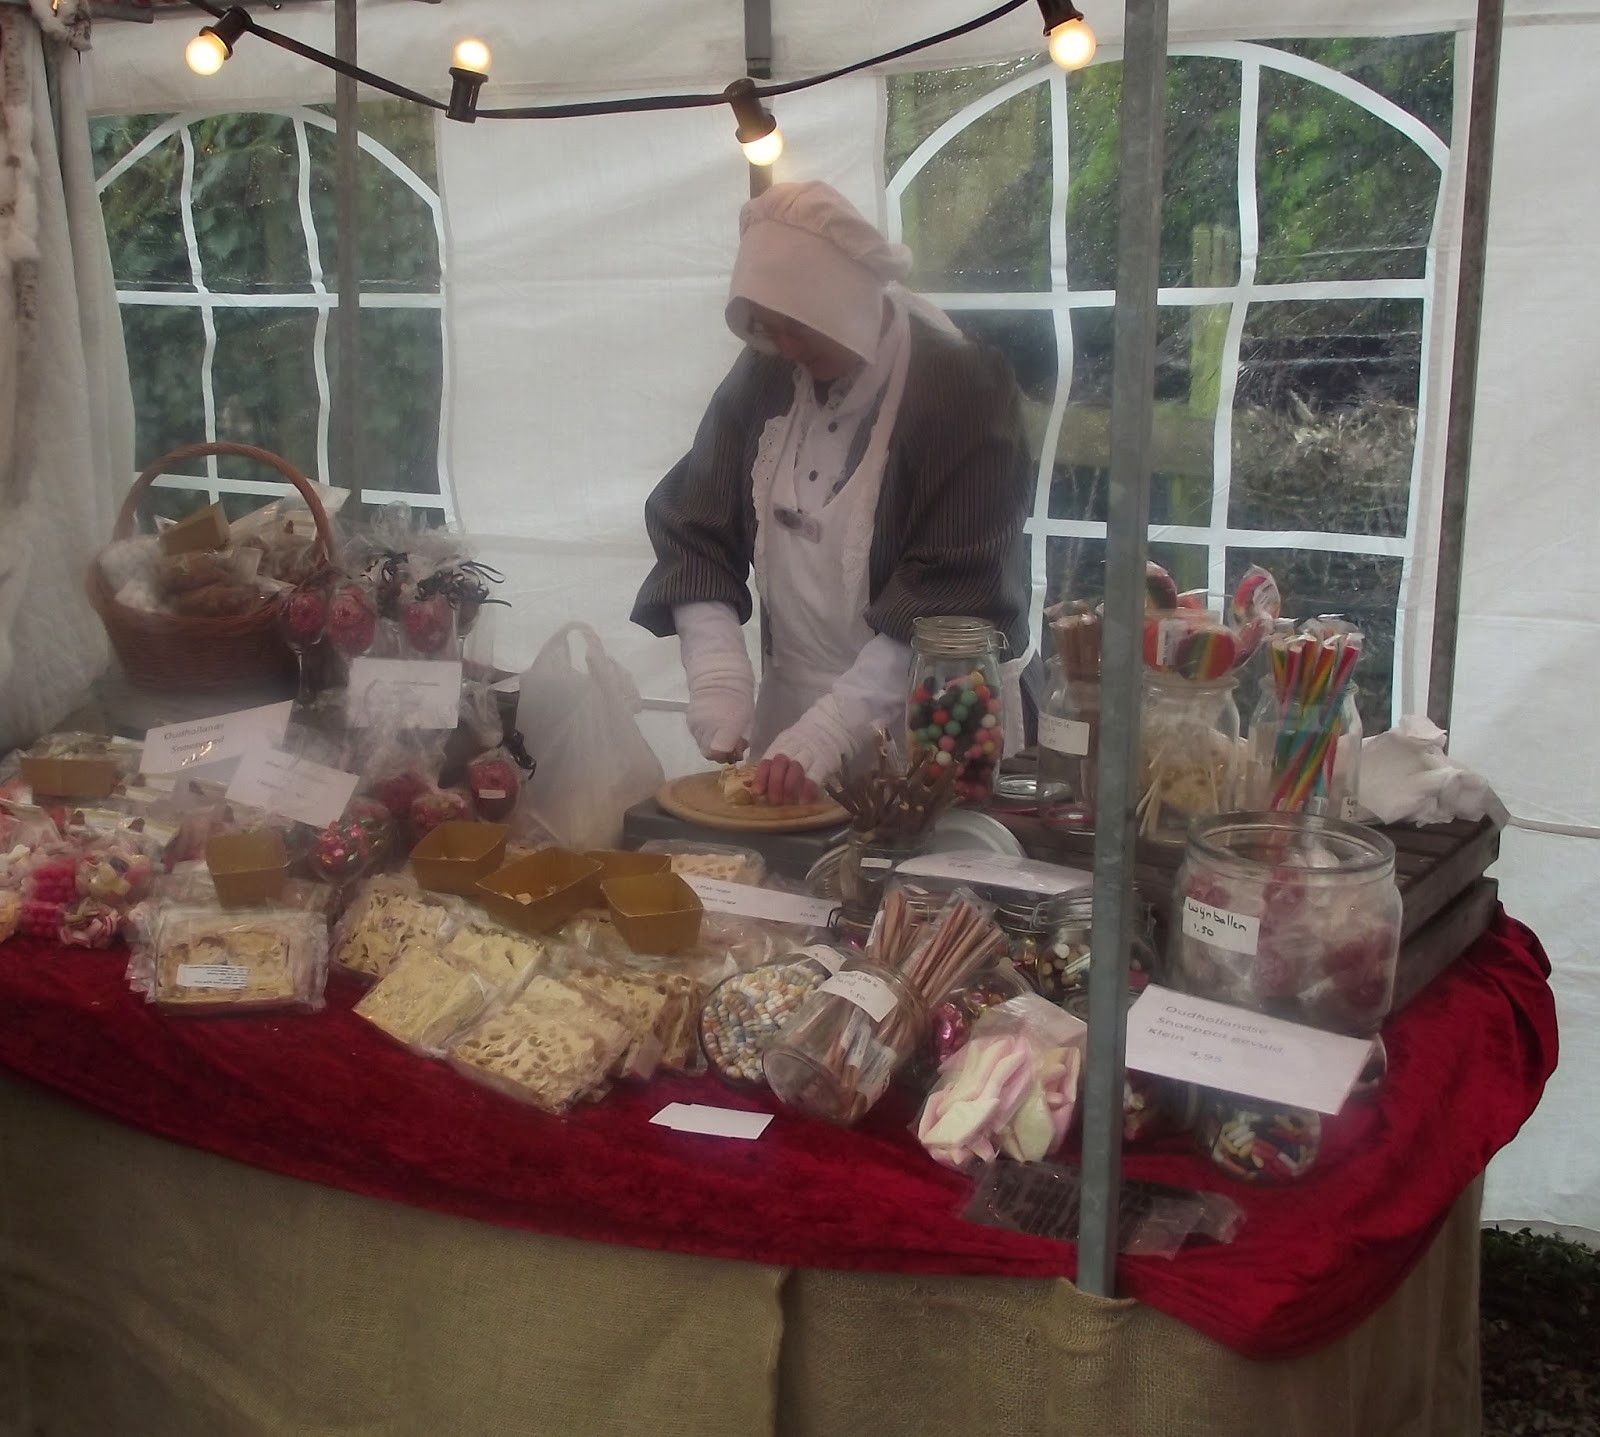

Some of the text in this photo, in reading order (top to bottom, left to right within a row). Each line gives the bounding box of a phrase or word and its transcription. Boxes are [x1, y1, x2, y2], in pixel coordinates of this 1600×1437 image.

[1193, 923, 1214, 937] 1.50
[1165, 1005, 1268, 1035] Oudhollandse
[1148, 1027, 1185, 1042] Klein
